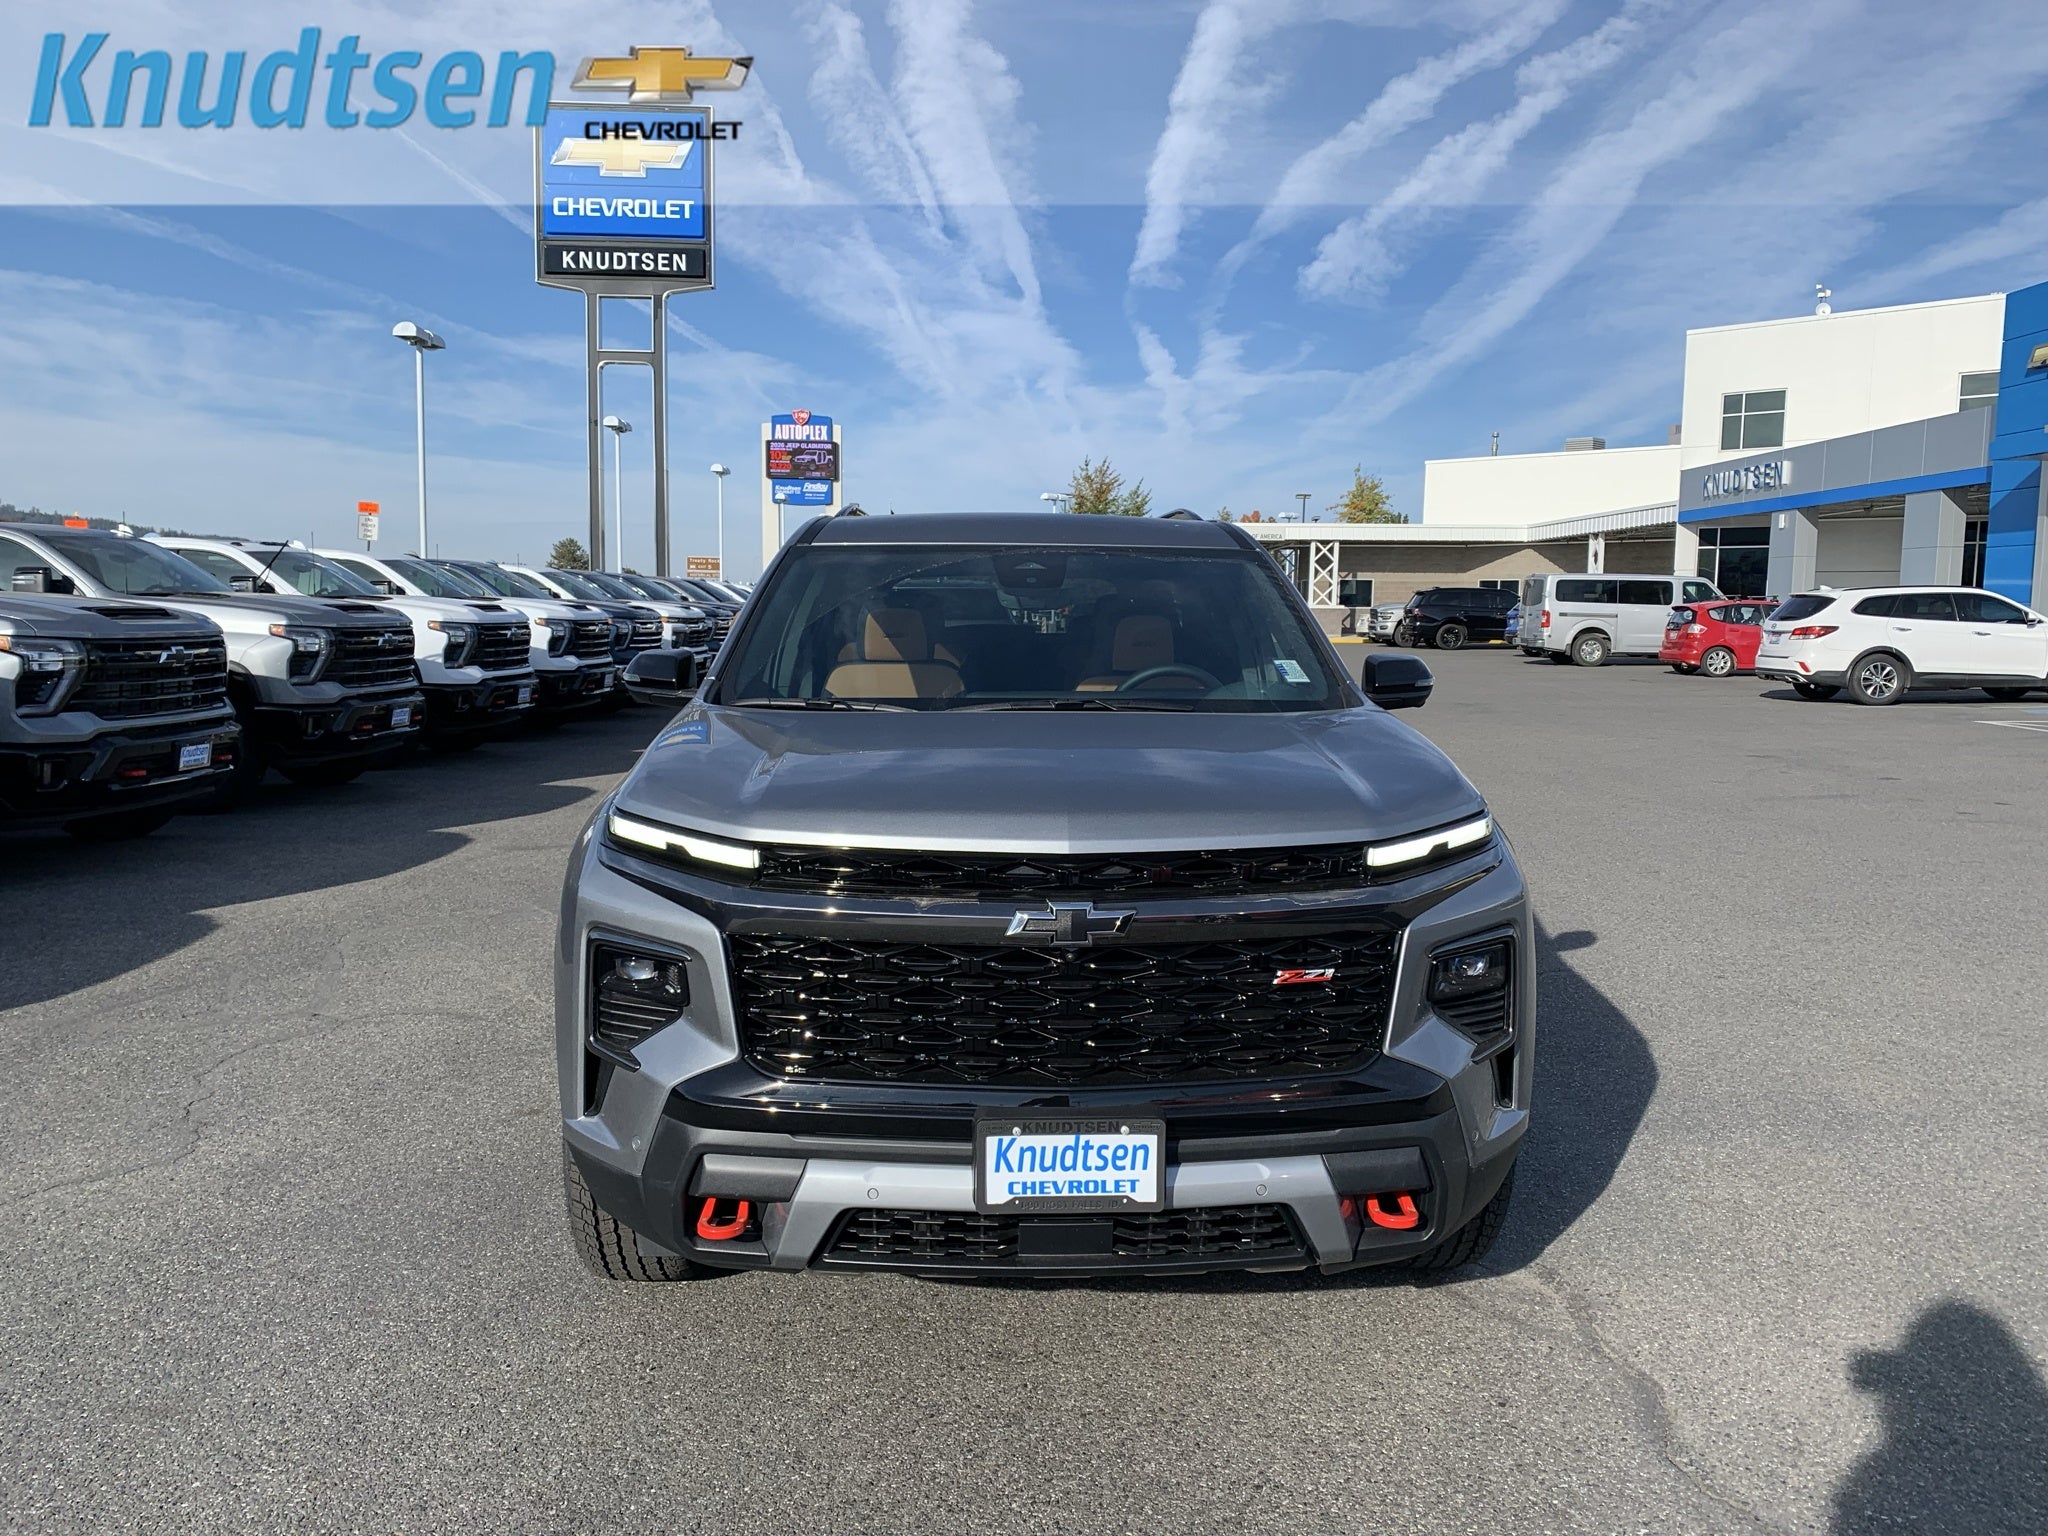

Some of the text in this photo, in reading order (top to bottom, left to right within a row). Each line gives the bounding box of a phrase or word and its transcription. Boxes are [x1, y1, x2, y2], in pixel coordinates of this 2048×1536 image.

[553, 197, 695, 219] CHEVROLET
[562, 250, 687, 271] KNUDTSEN
[774, 424, 828, 440] AUTOPLEX
[1703, 460, 1783, 497] KNUDTSEN
[1021, 1121, 1121, 1133] KNUDTSEN
[994, 1135, 1150, 1173] Knudtsen
[1008, 1179, 1140, 1195] CHEVROLET
